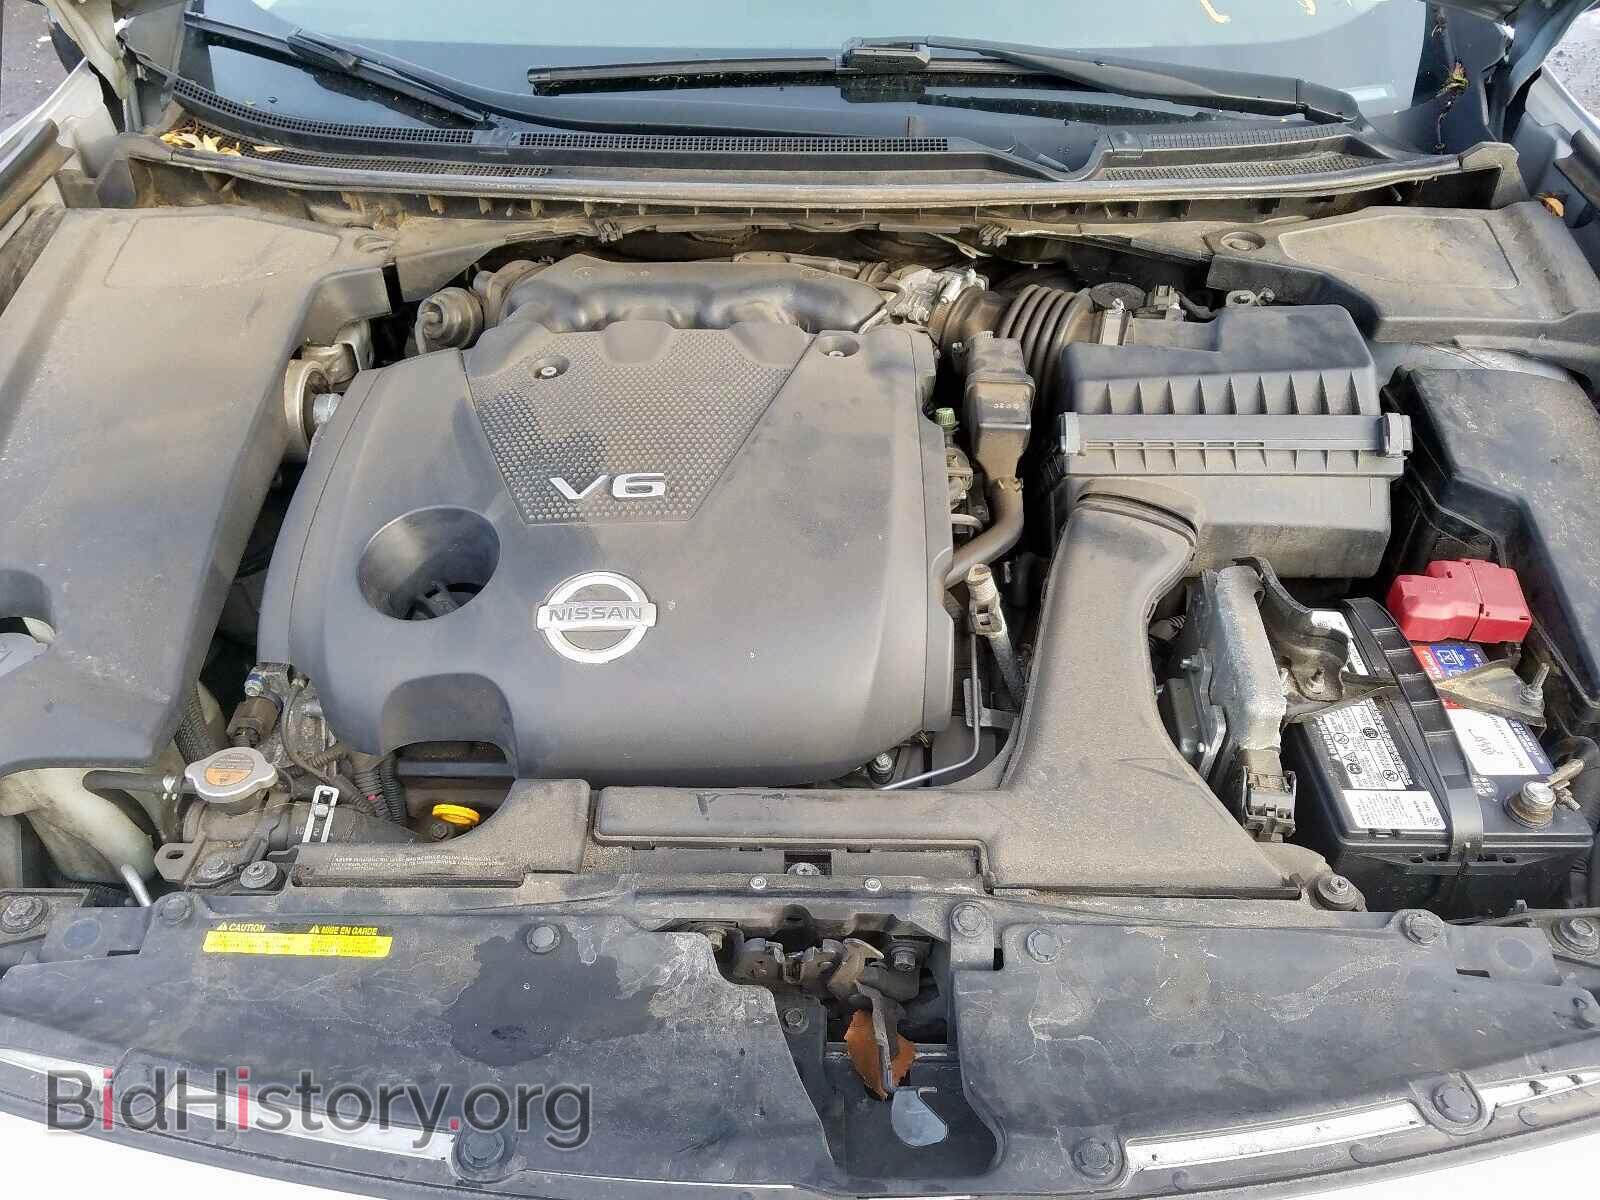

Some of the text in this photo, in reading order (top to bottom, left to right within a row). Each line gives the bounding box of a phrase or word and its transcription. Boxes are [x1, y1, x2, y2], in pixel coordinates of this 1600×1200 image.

[549, 472, 666, 500] V6
[549, 605, 641, 621] NISSAN
[228, 923, 266, 933] CAUTION
[340, 927, 351, 935] EN
[351, 927, 379, 936] GARDE
